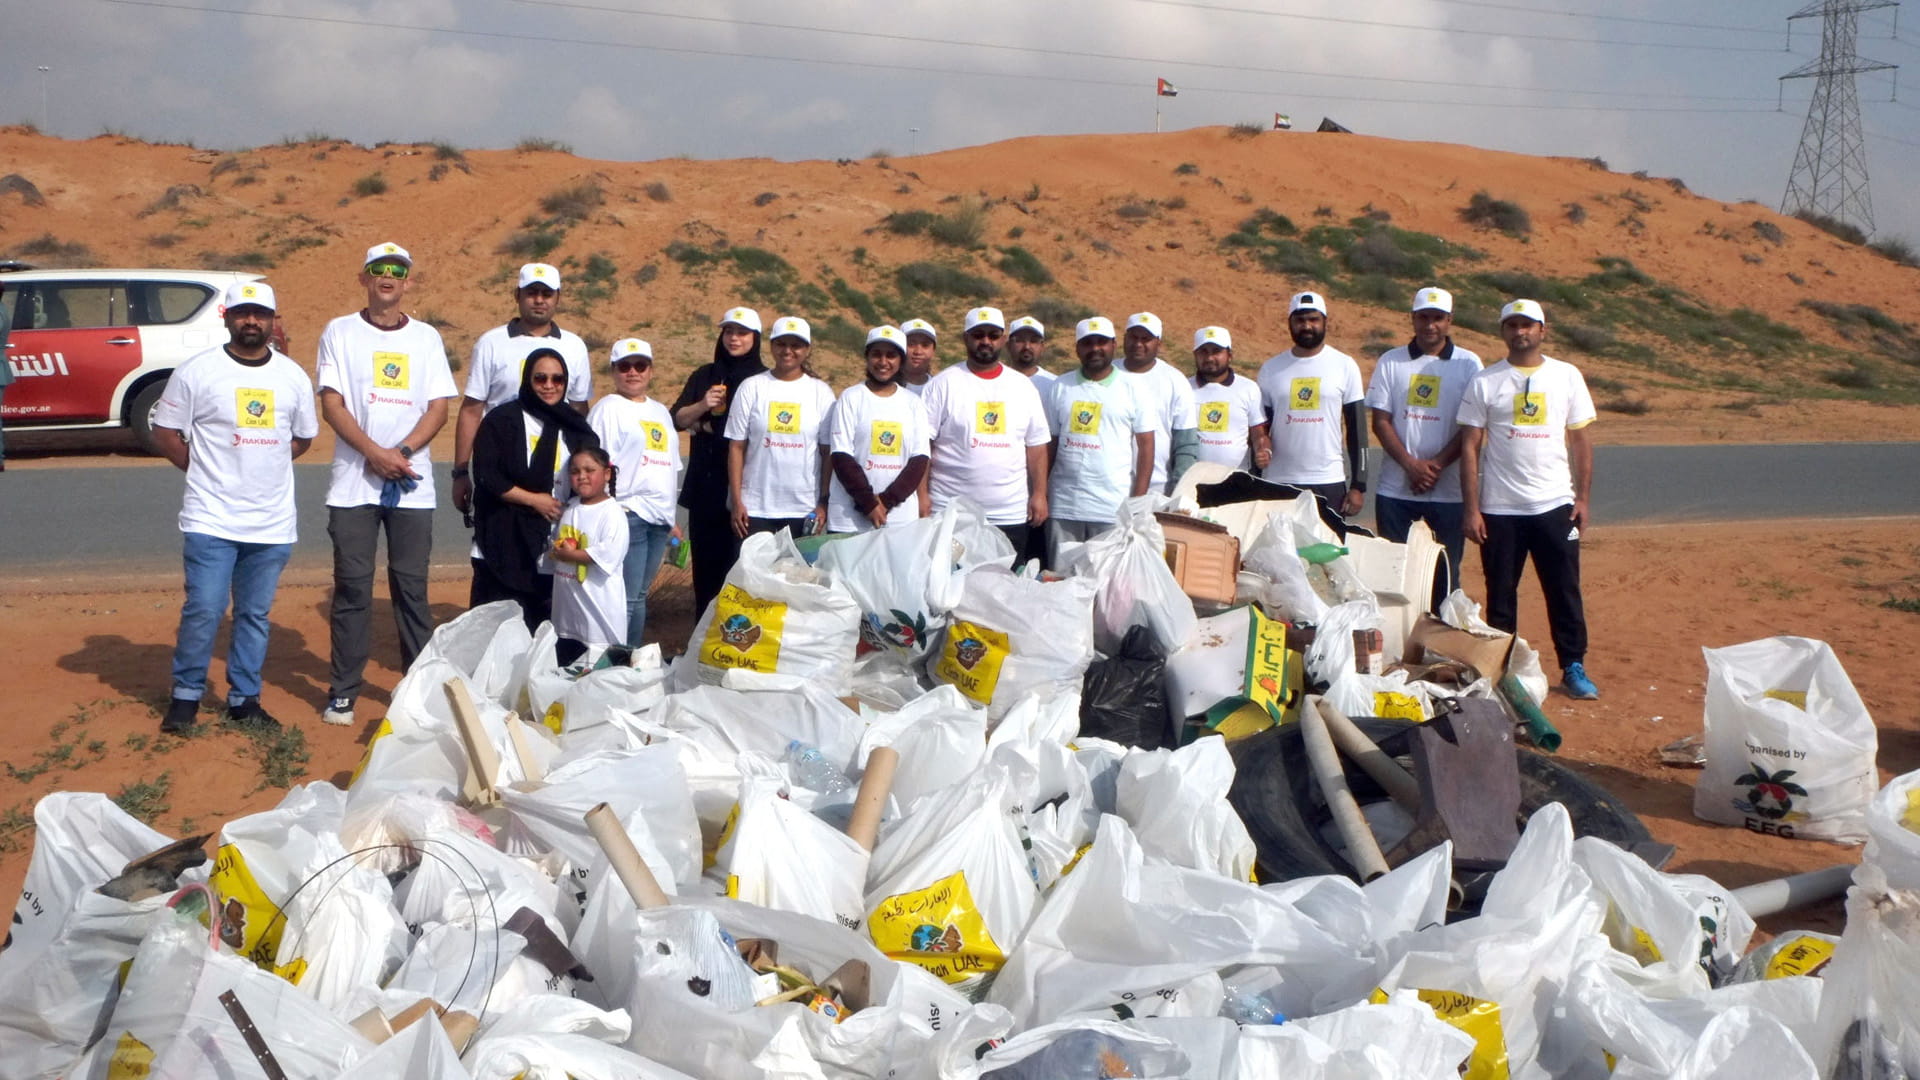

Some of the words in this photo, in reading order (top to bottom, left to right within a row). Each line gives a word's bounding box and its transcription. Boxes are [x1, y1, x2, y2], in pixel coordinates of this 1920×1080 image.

[0, 405, 51, 414] lice.gov.ae
[1793, 749, 1806, 760] by
[1744, 816, 1795, 839] EEG
